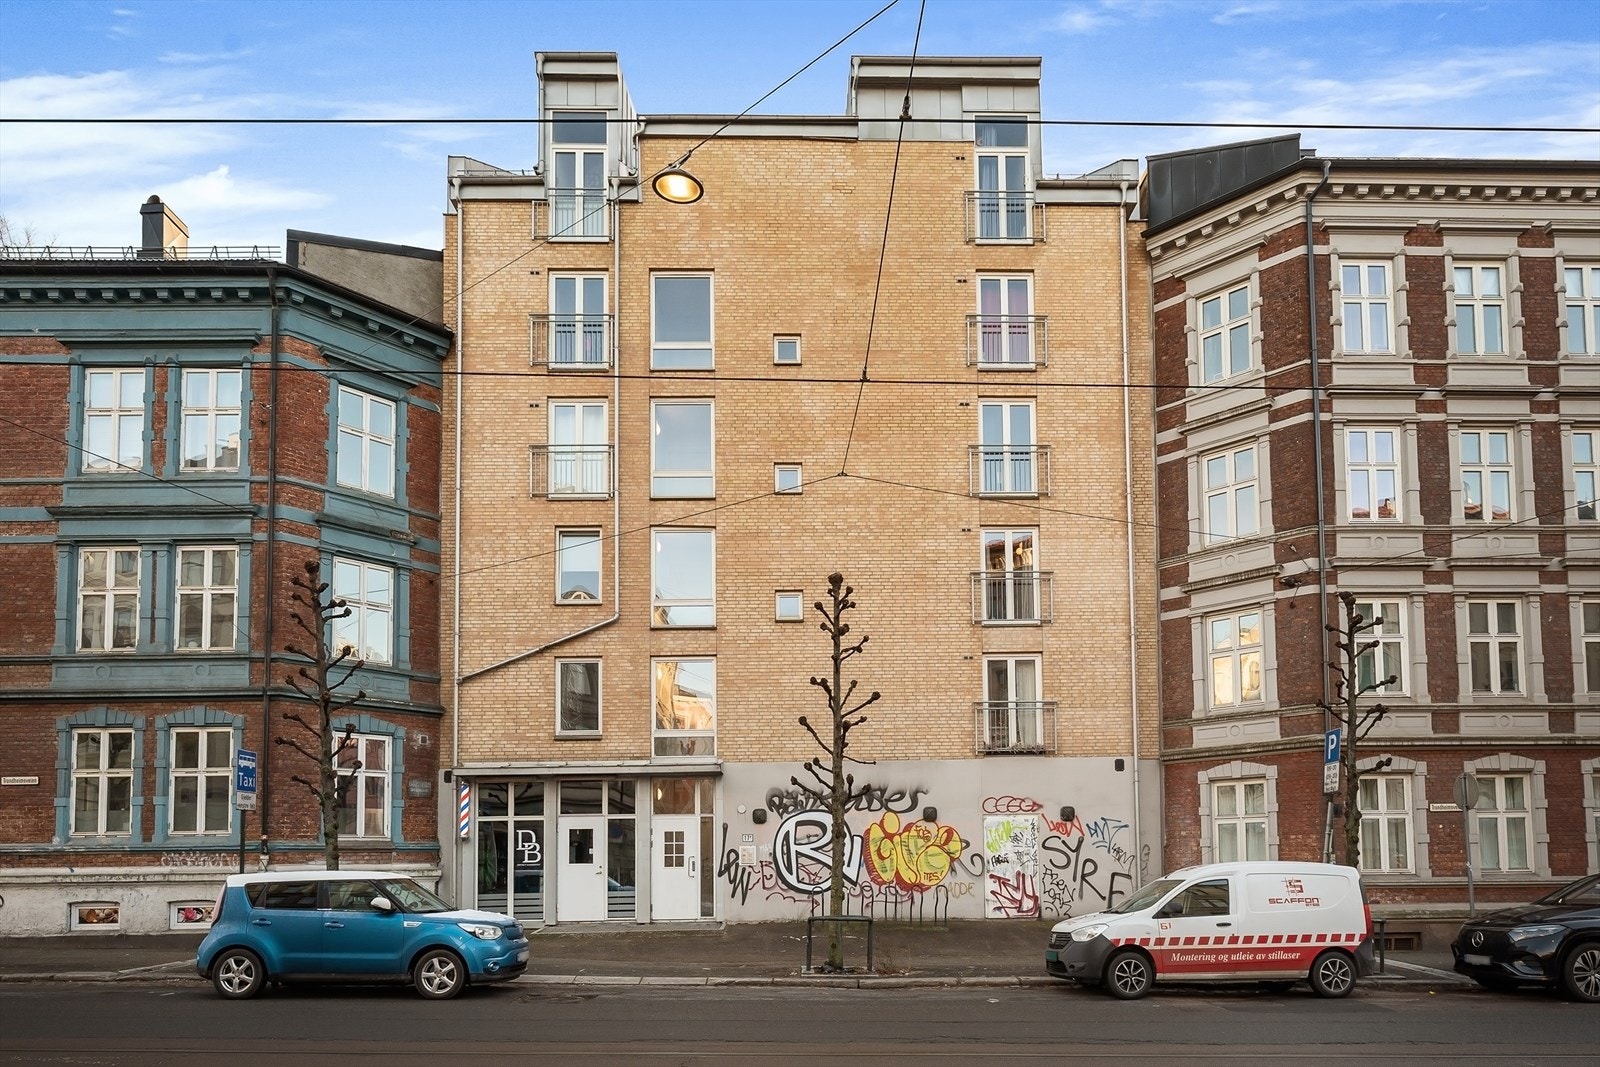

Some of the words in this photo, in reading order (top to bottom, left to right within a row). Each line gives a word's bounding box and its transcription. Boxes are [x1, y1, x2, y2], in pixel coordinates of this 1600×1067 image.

[1328, 734, 1337, 760] P
[238, 771, 256, 788] Taxi
[1160, 922, 1172, 930] 61
[1171, 951, 1216, 963] Montering
[1218, 953, 1229, 962] og
[1231, 951, 1254, 960] utleie
[1256, 952, 1265, 960] av
[1268, 950, 1301, 960] stillaser
